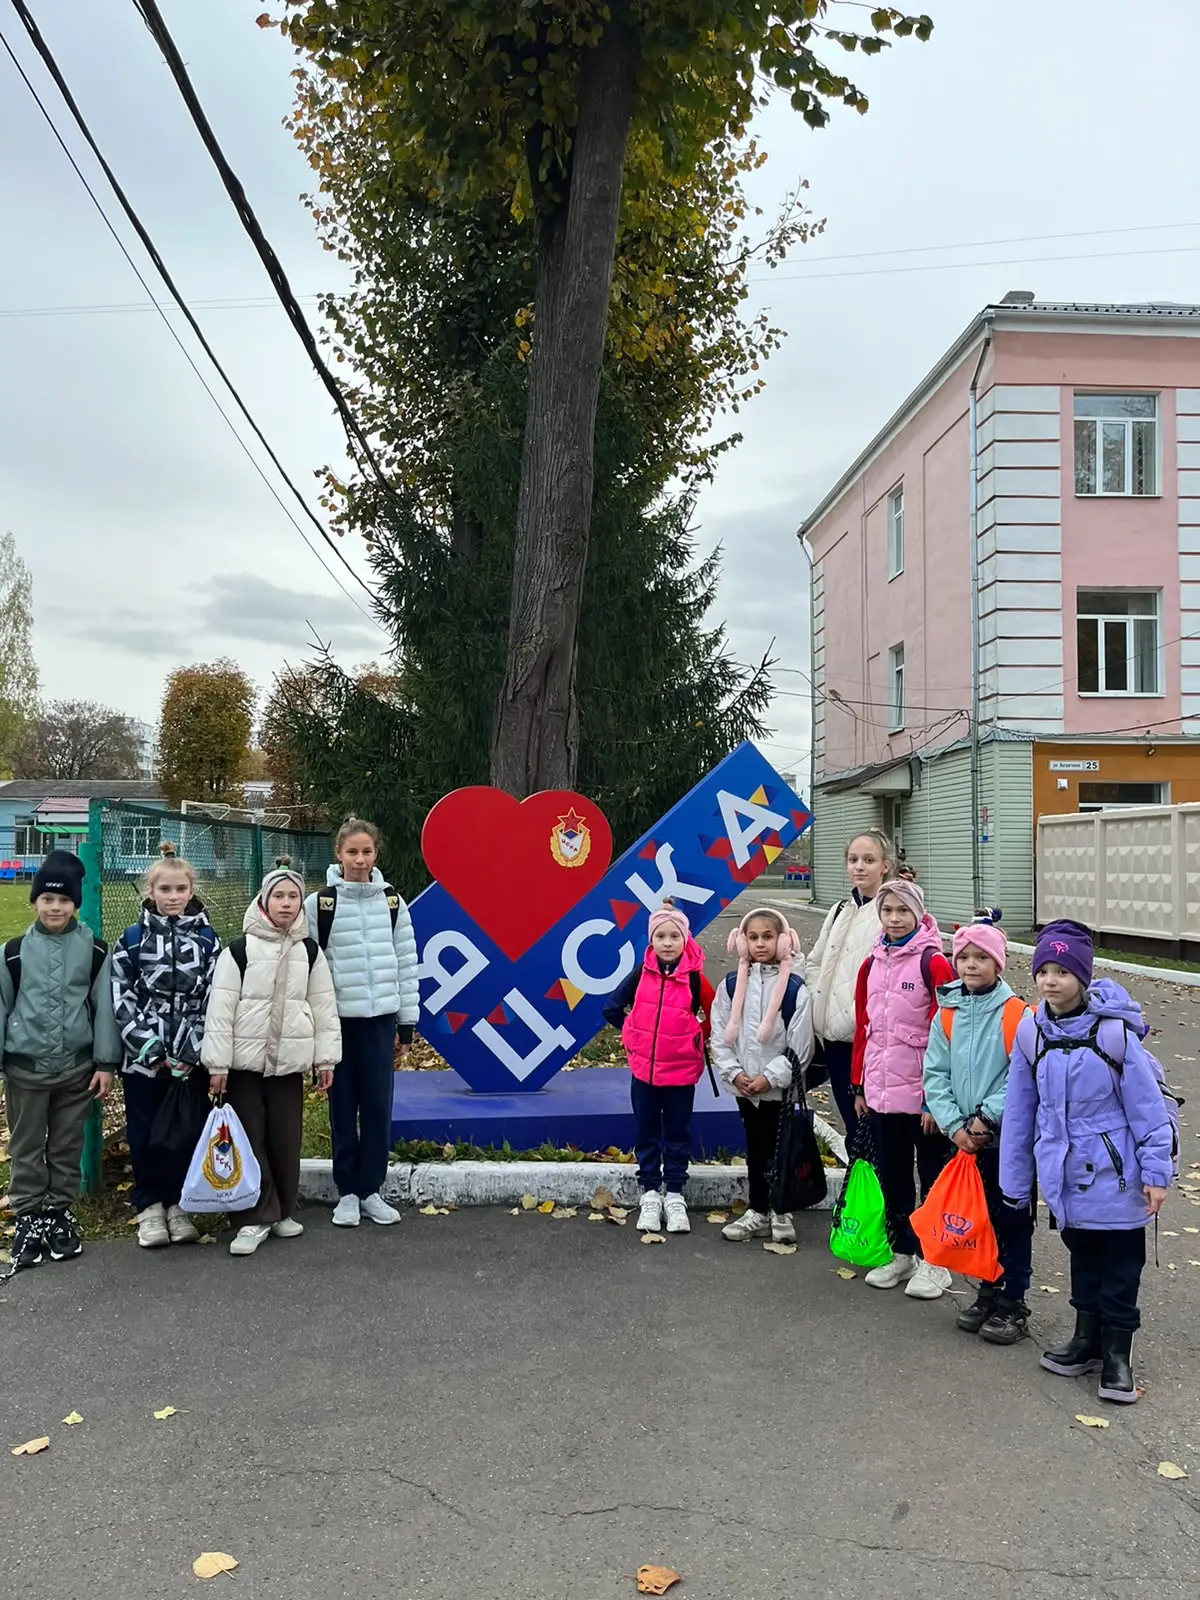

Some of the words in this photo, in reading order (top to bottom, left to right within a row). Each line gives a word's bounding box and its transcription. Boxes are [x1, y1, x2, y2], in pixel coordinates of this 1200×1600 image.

[417, 930, 490, 1016] Я
[471, 789, 790, 1082] ЦСКА
[931, 1224, 977, 1249] SPSM
